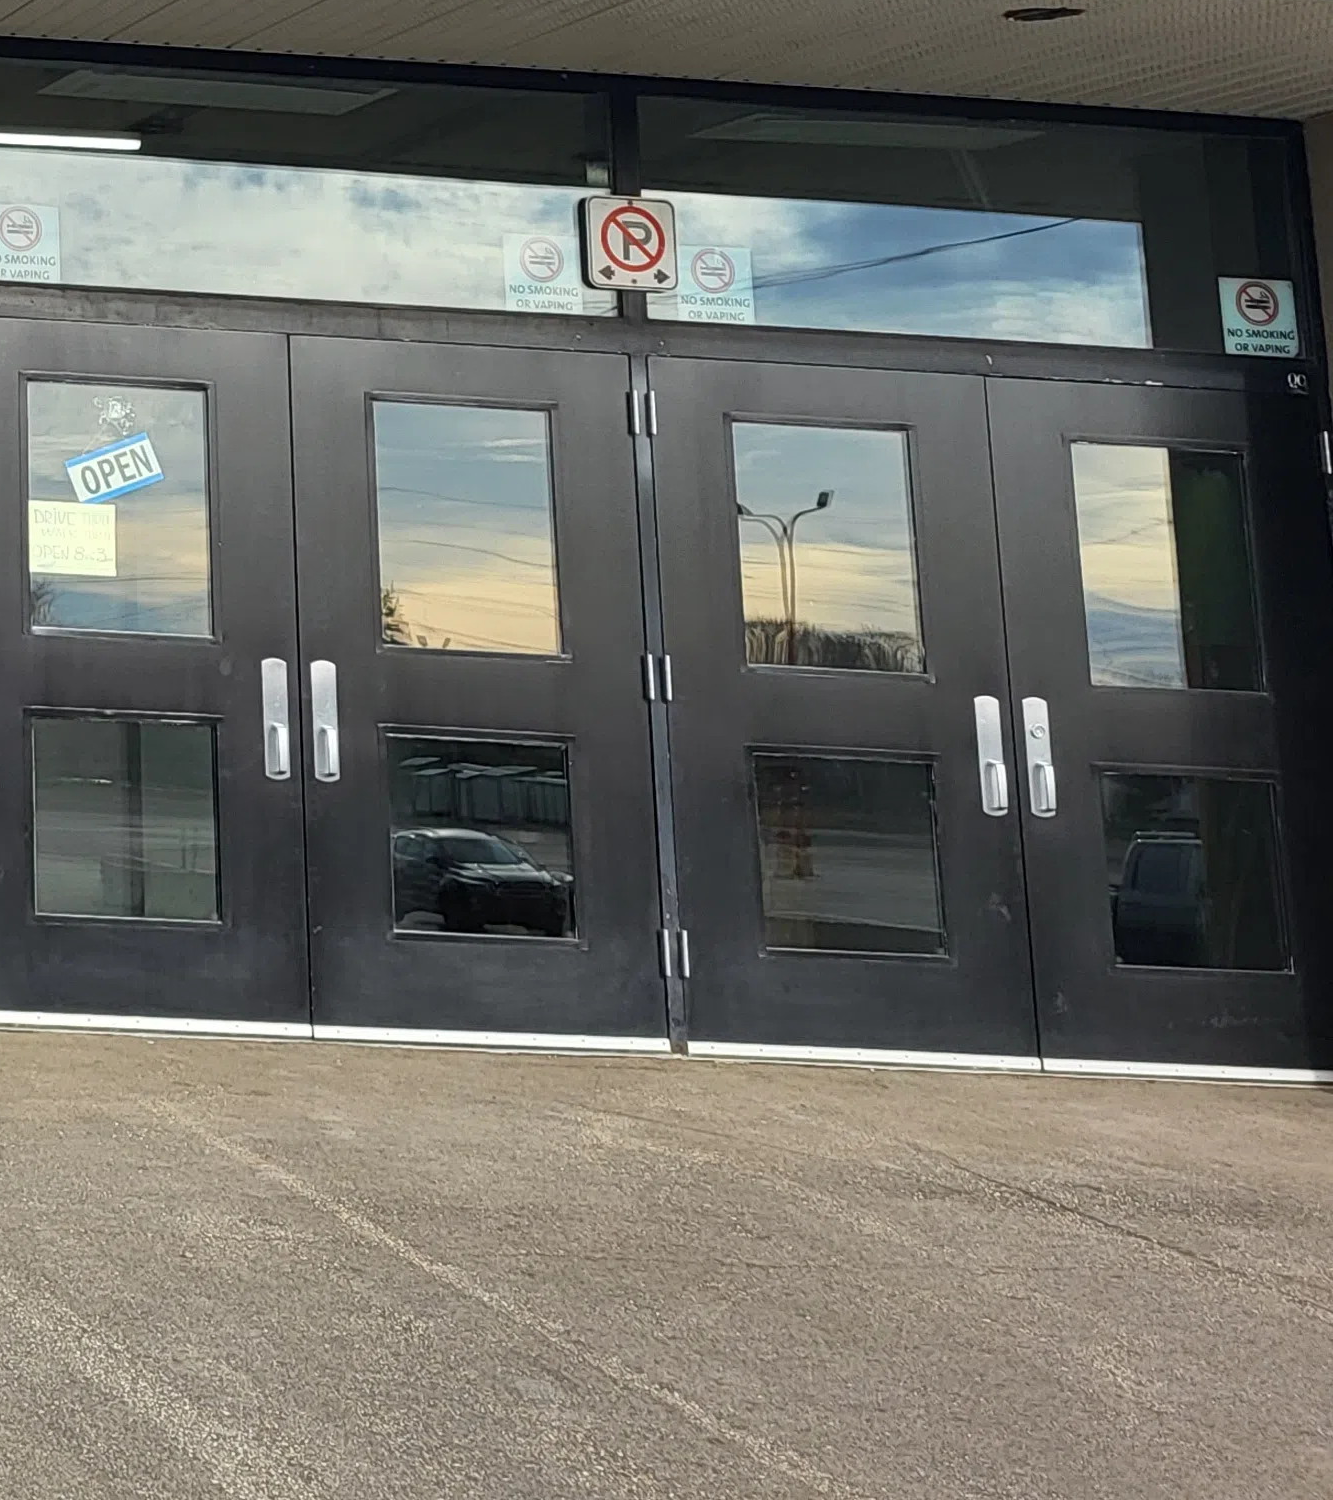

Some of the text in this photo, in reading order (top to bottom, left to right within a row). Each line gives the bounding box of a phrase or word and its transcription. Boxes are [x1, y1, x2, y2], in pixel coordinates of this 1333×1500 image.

[4, 255, 57, 267] SMOKING
[10, 269, 50, 280] VAPING
[509, 284, 579, 298] NO SMOKING
[516, 299, 574, 311] OR VAPING
[681, 295, 751, 308] NO SMOKING
[688, 310, 745, 322] OR VAPING
[1227, 328, 1295, 340] NO SMOKING
[1235, 343, 1290, 354] OR VAPING
[81, 444, 154, 495] OPEN
[34, 508, 77, 525] DRIVE
[33, 544, 69, 560] OPEN
